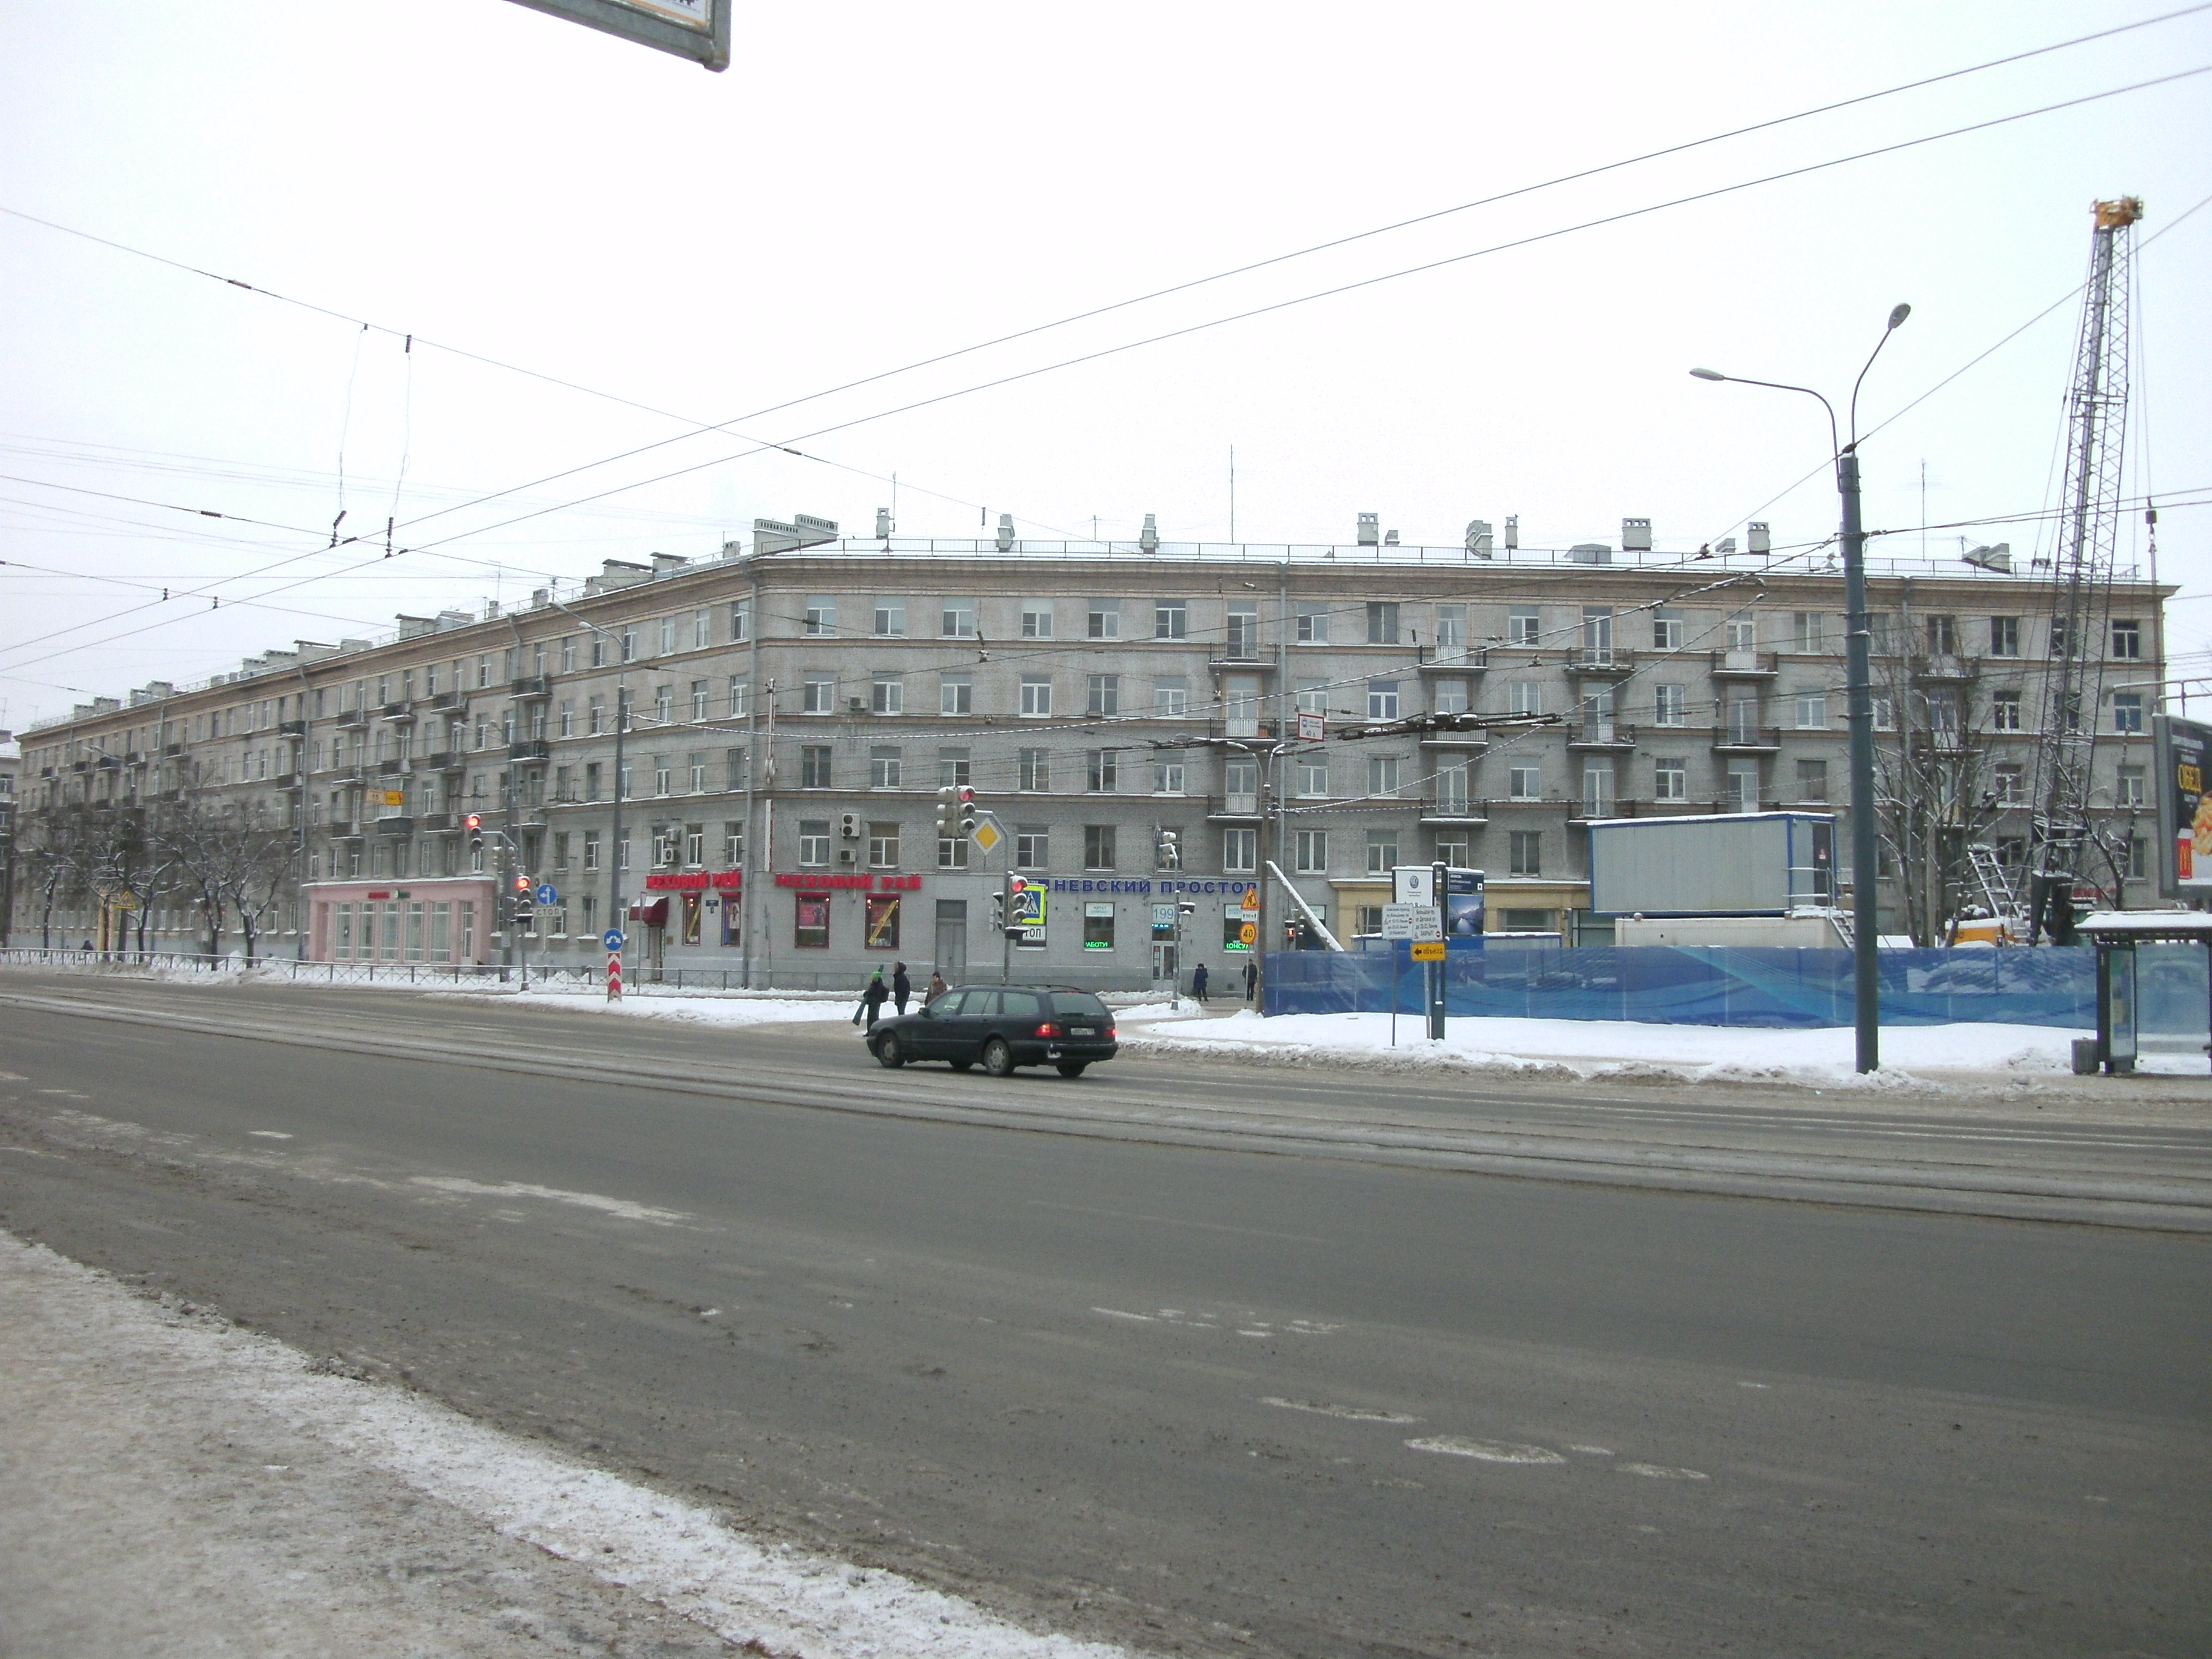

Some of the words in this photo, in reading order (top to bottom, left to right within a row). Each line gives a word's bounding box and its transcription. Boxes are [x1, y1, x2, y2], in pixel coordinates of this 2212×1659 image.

[646, 870, 709, 890] МЕХОВОЙ
[712, 868, 742, 888] РАЙ
[775, 873, 874, 889] МЕХОВОЙ
[881, 874, 922, 890] РАЙ
[1054, 877, 1151, 893] НЕВСКИЙ
[1160, 881, 1257, 894] ПРОСТОР
[1025, 928, 1041, 937] ТОП
